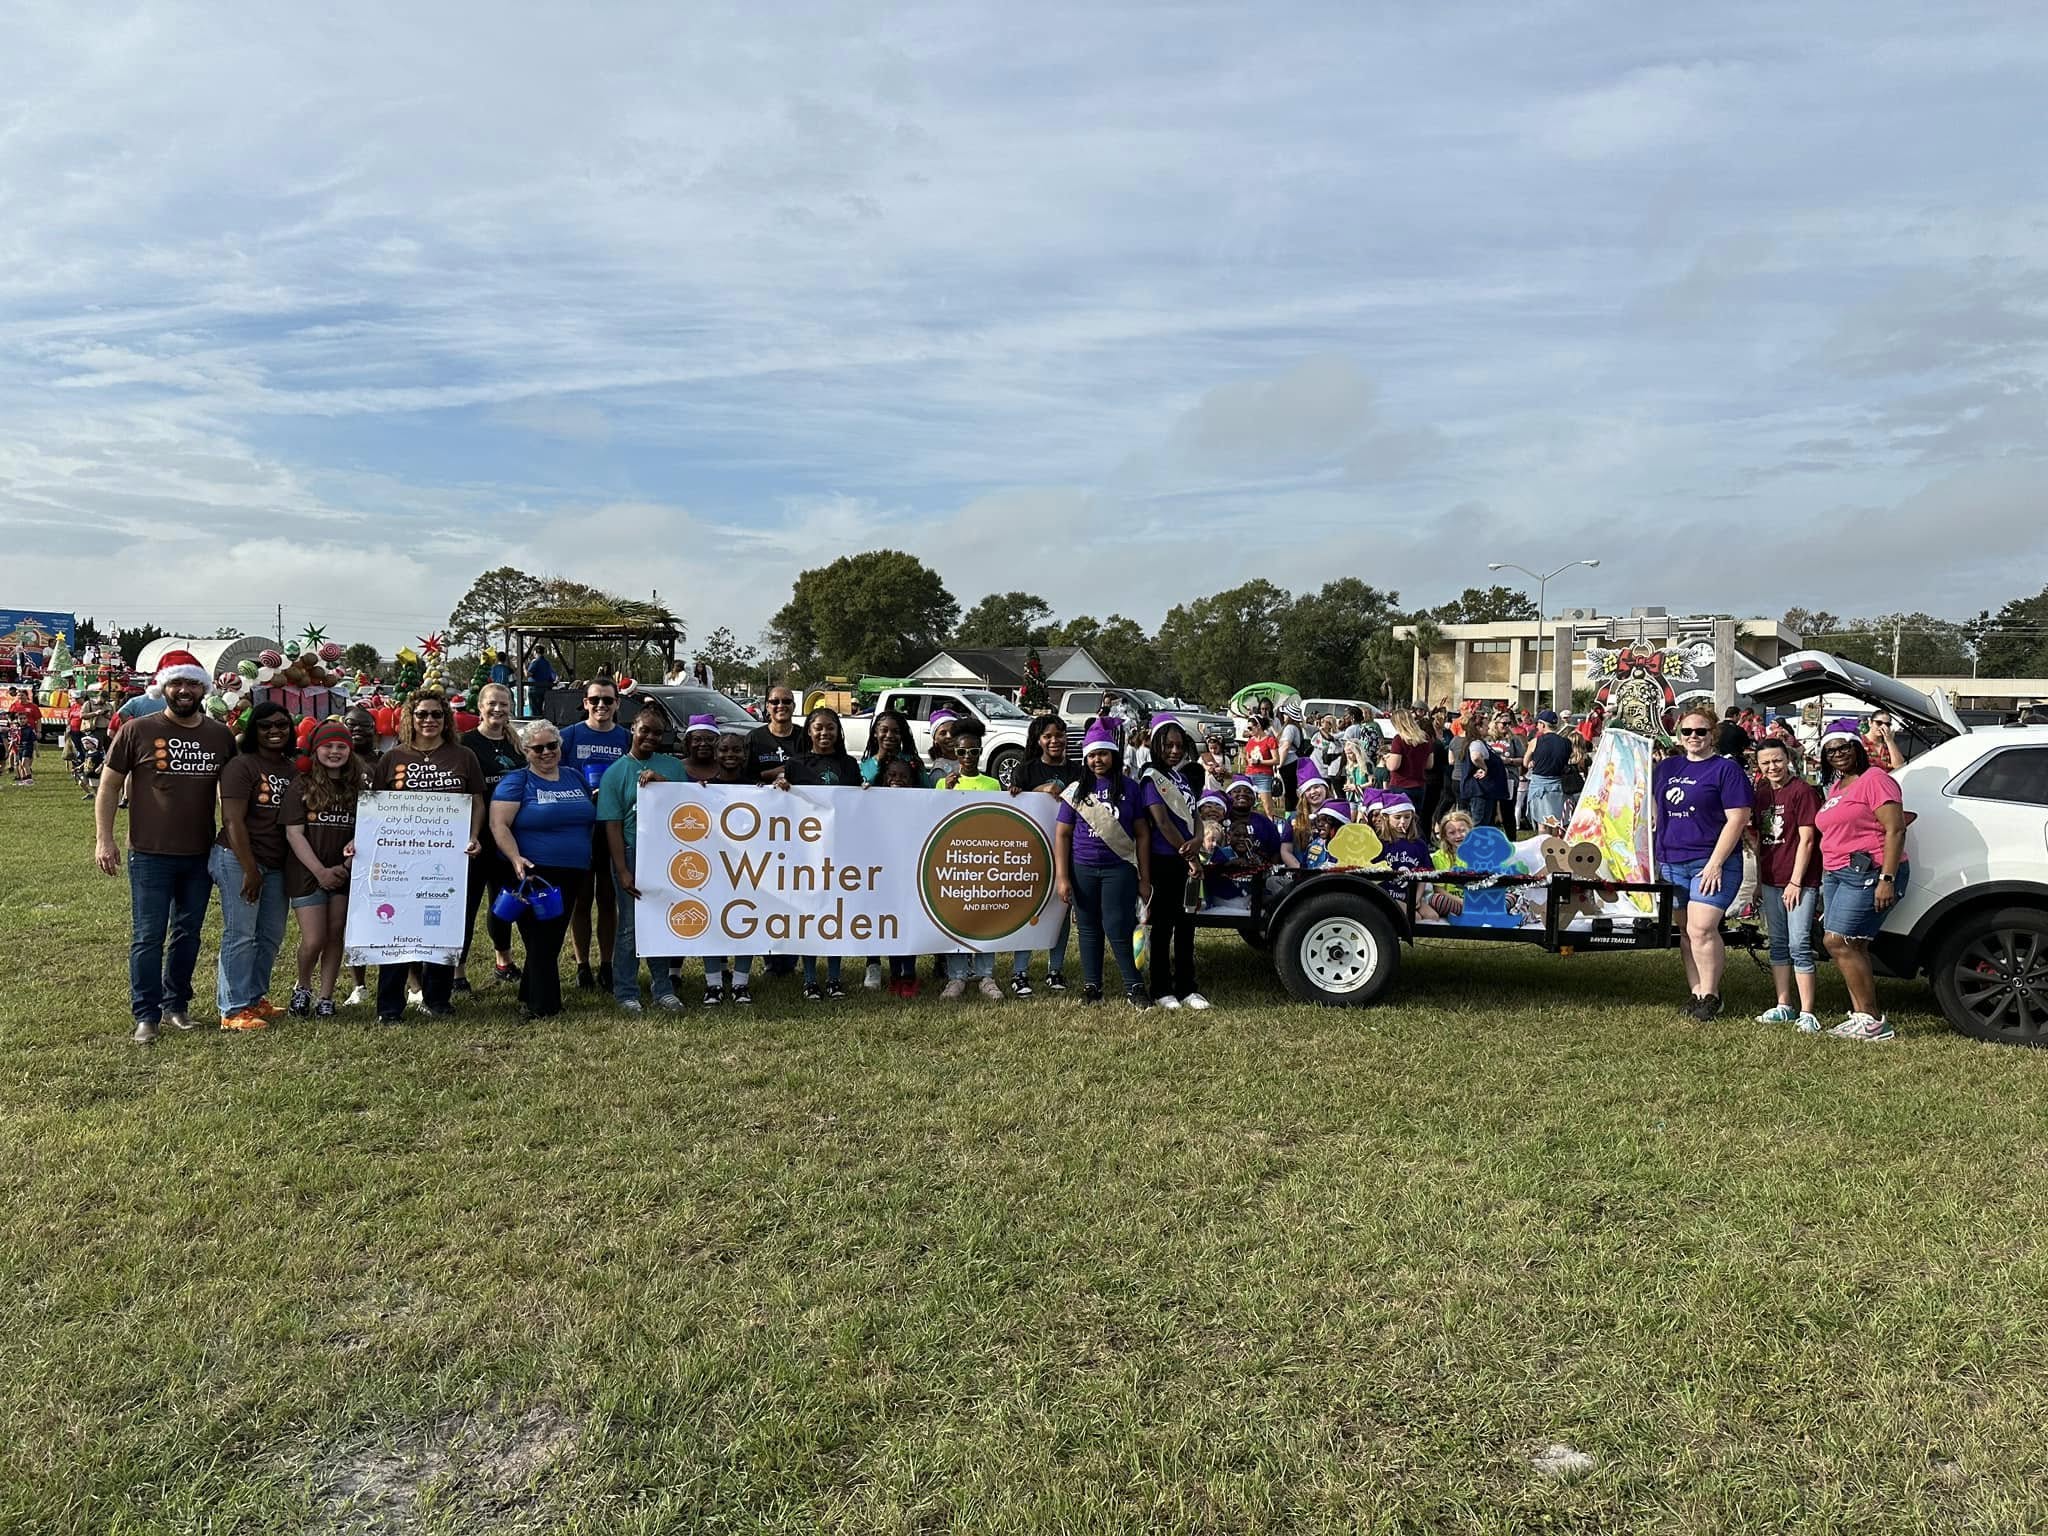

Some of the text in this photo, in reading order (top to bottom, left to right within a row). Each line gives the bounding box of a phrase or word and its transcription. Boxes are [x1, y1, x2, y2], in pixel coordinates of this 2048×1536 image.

[168, 738, 200, 749] One
[168, 749, 216, 760] Winter
[591, 745, 622, 756] CIRCLES
[407, 763, 437, 772] One
[406, 770, 453, 780] Winter
[406, 777, 461, 788] Garden
[388, 792, 402, 800] For
[405, 793, 424, 801] unto
[425, 794, 442, 805] you
[377, 803, 460, 815] born this day in the
[385, 816, 402, 825] city
[404, 815, 413, 824] of
[415, 815, 441, 825] David
[719, 801, 822, 843] One
[380, 826, 454, 837] Saviour, which is
[376, 838, 455, 849] Christ the Lord.
[950, 839, 1029, 848] ADVOCATING FOR THE
[946, 849, 1032, 865] Historic East
[719, 850, 883, 892] Winter
[935, 866, 1039, 881] Winter Garden
[416, 890, 427, 899] girl
[940, 884, 1033, 902] Neighborhood
[963, 903, 1010, 911] AND BEYOND
[720, 898, 898, 940] Garden
[381, 948, 433, 957] Neighborhood
